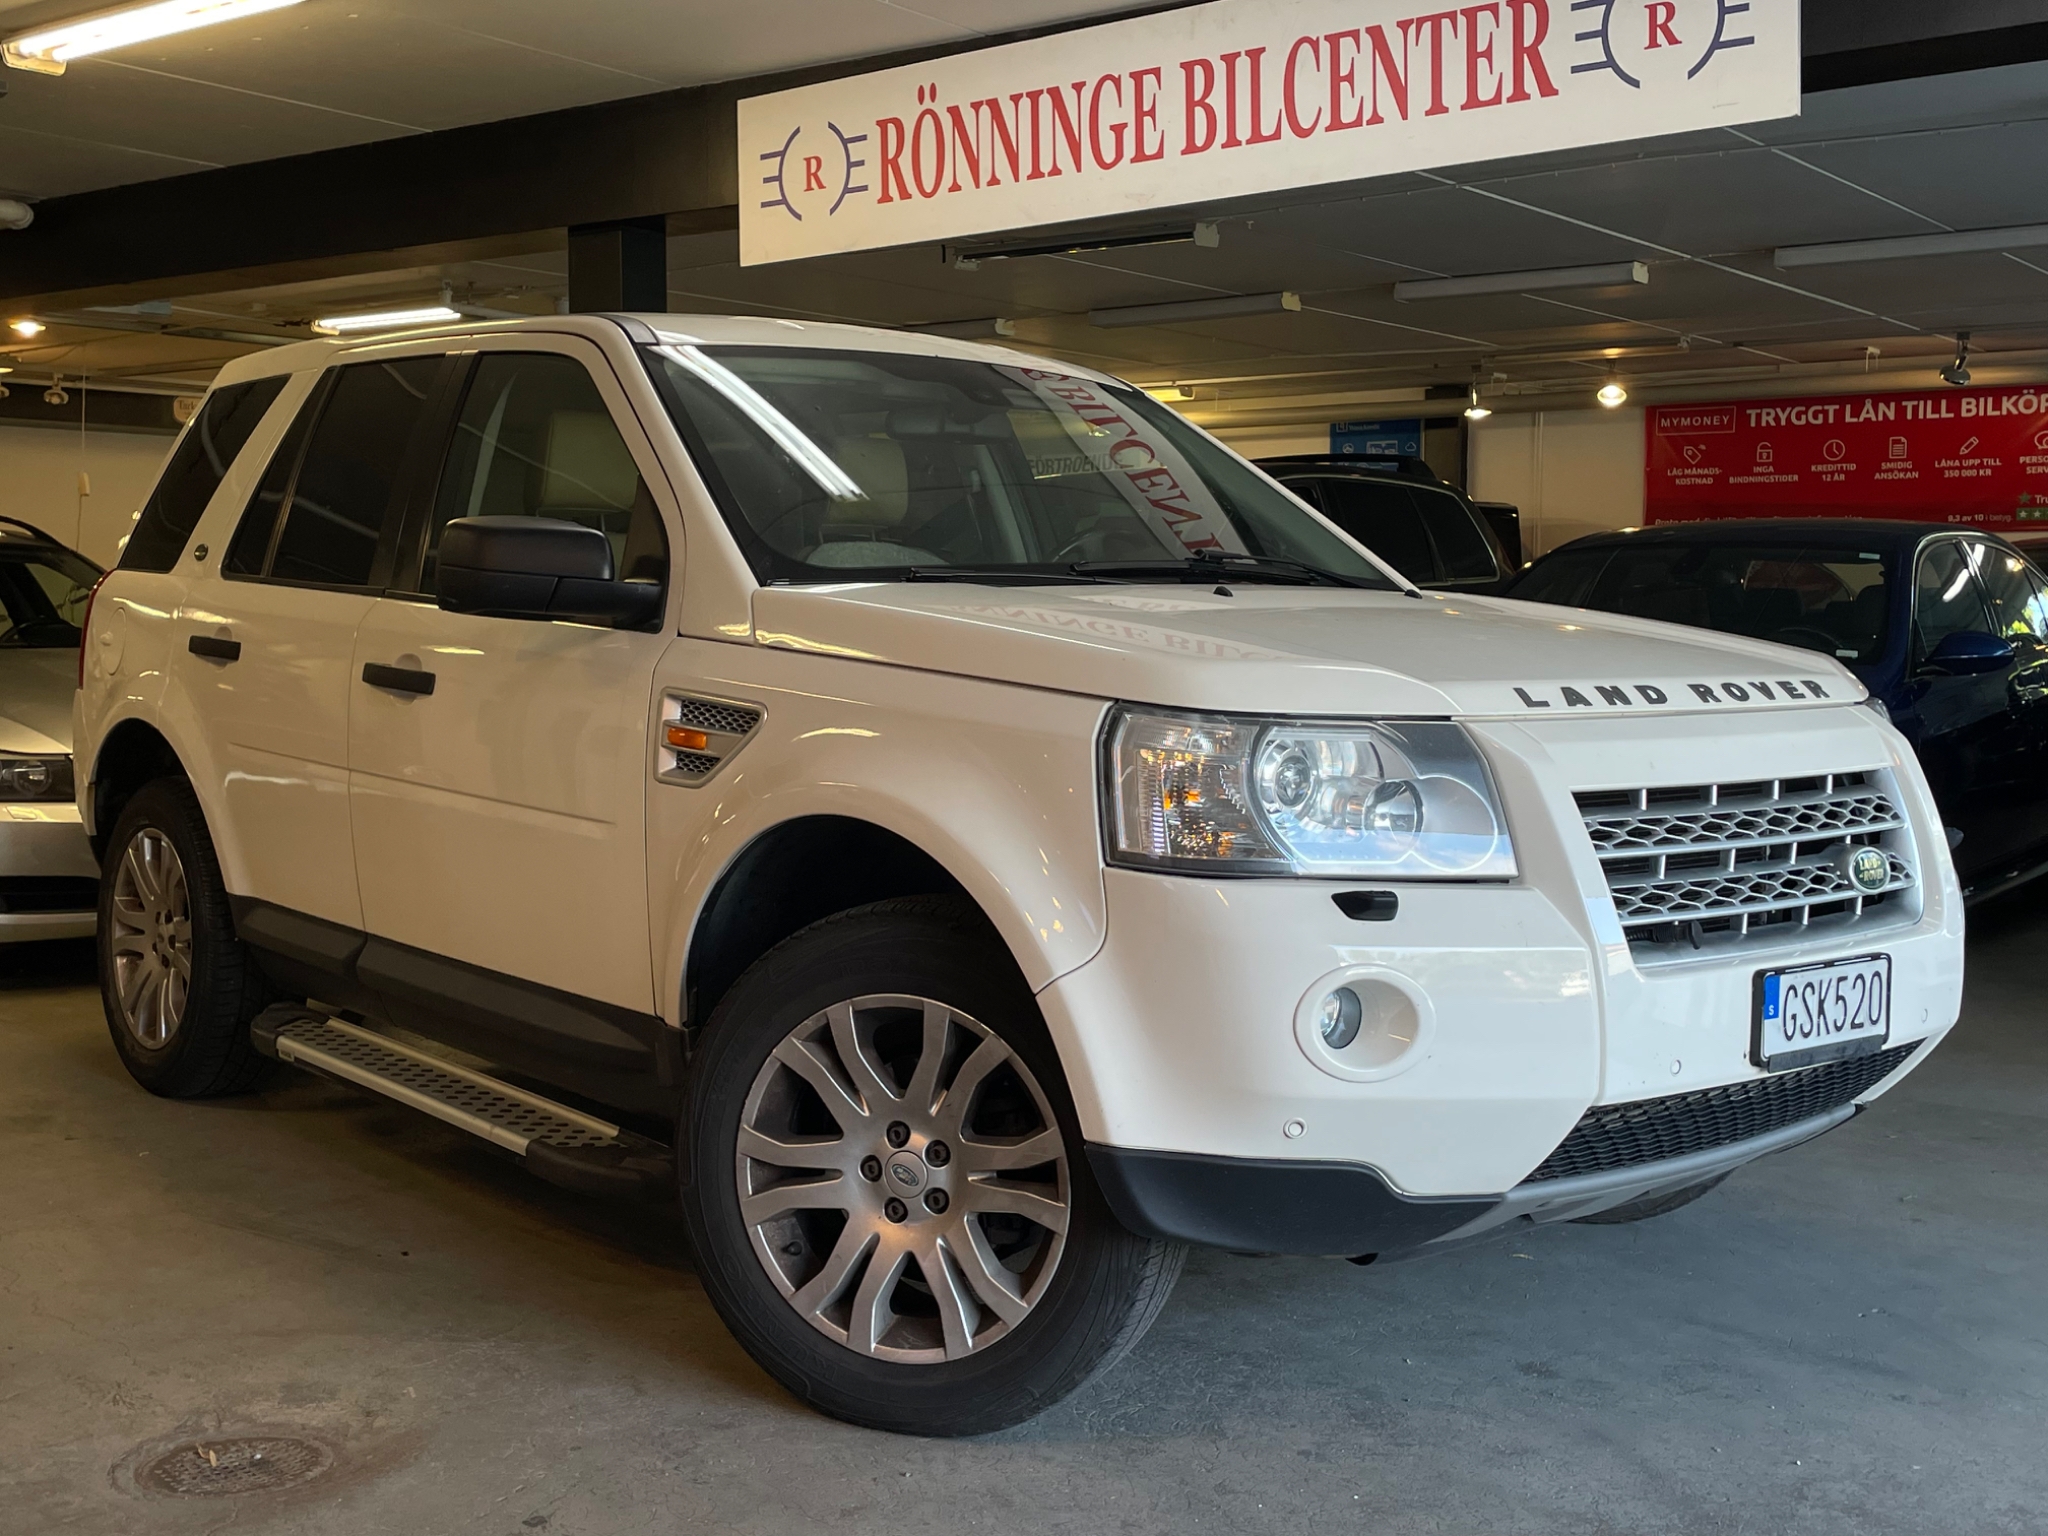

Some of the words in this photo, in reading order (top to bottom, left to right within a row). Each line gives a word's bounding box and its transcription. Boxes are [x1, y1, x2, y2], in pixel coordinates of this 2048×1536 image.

[1643, 1, 1682, 50] R
[876, 66, 1165, 204] RÖNNINGE
[1180, 0, 1559, 156] BILCENTER
[803, 155, 827, 192] R
[1746, 405, 1839, 427] TRYGGT
[1845, 398, 1896, 423] LÅN
[1902, 399, 1955, 421] TILL
[1661, 415, 1730, 428] MYMONEY
[1881, 461, 1913, 470] SMIDIG
[1935, 458, 1960, 468] LÅNA
[1962, 458, 1981, 467] UPP
[1983, 457, 2002, 466] TILL
[1667, 468, 1683, 477] LÅG
[1684, 467, 1722, 476] MÅNADS-
[1753, 465, 1774, 474] INGA
[1811, 463, 1856, 473] KREDITTID
[1961, 469, 1978, 477] 000
[1979, 468, 1992, 477] KR
[1729, 474, 1799, 484] BINDNINGSTIDER
[1822, 474, 1831, 482] 12
[1833, 472, 1845, 482] ÅR
[1874, 470, 1919, 480] ANSÖKAN
[1675, 477, 1714, 486] KOSTNAD
[1947, 514, 1960, 523] 9,3
[1974, 513, 1984, 522] 10
[1513, 684, 1668, 708] LAND
[1687, 680, 1831, 704] ROVER
[1863, 868, 1884, 881] ROVER
[1768, 1005, 1775, 1016] S
[1783, 970, 1882, 1041] GSK520
